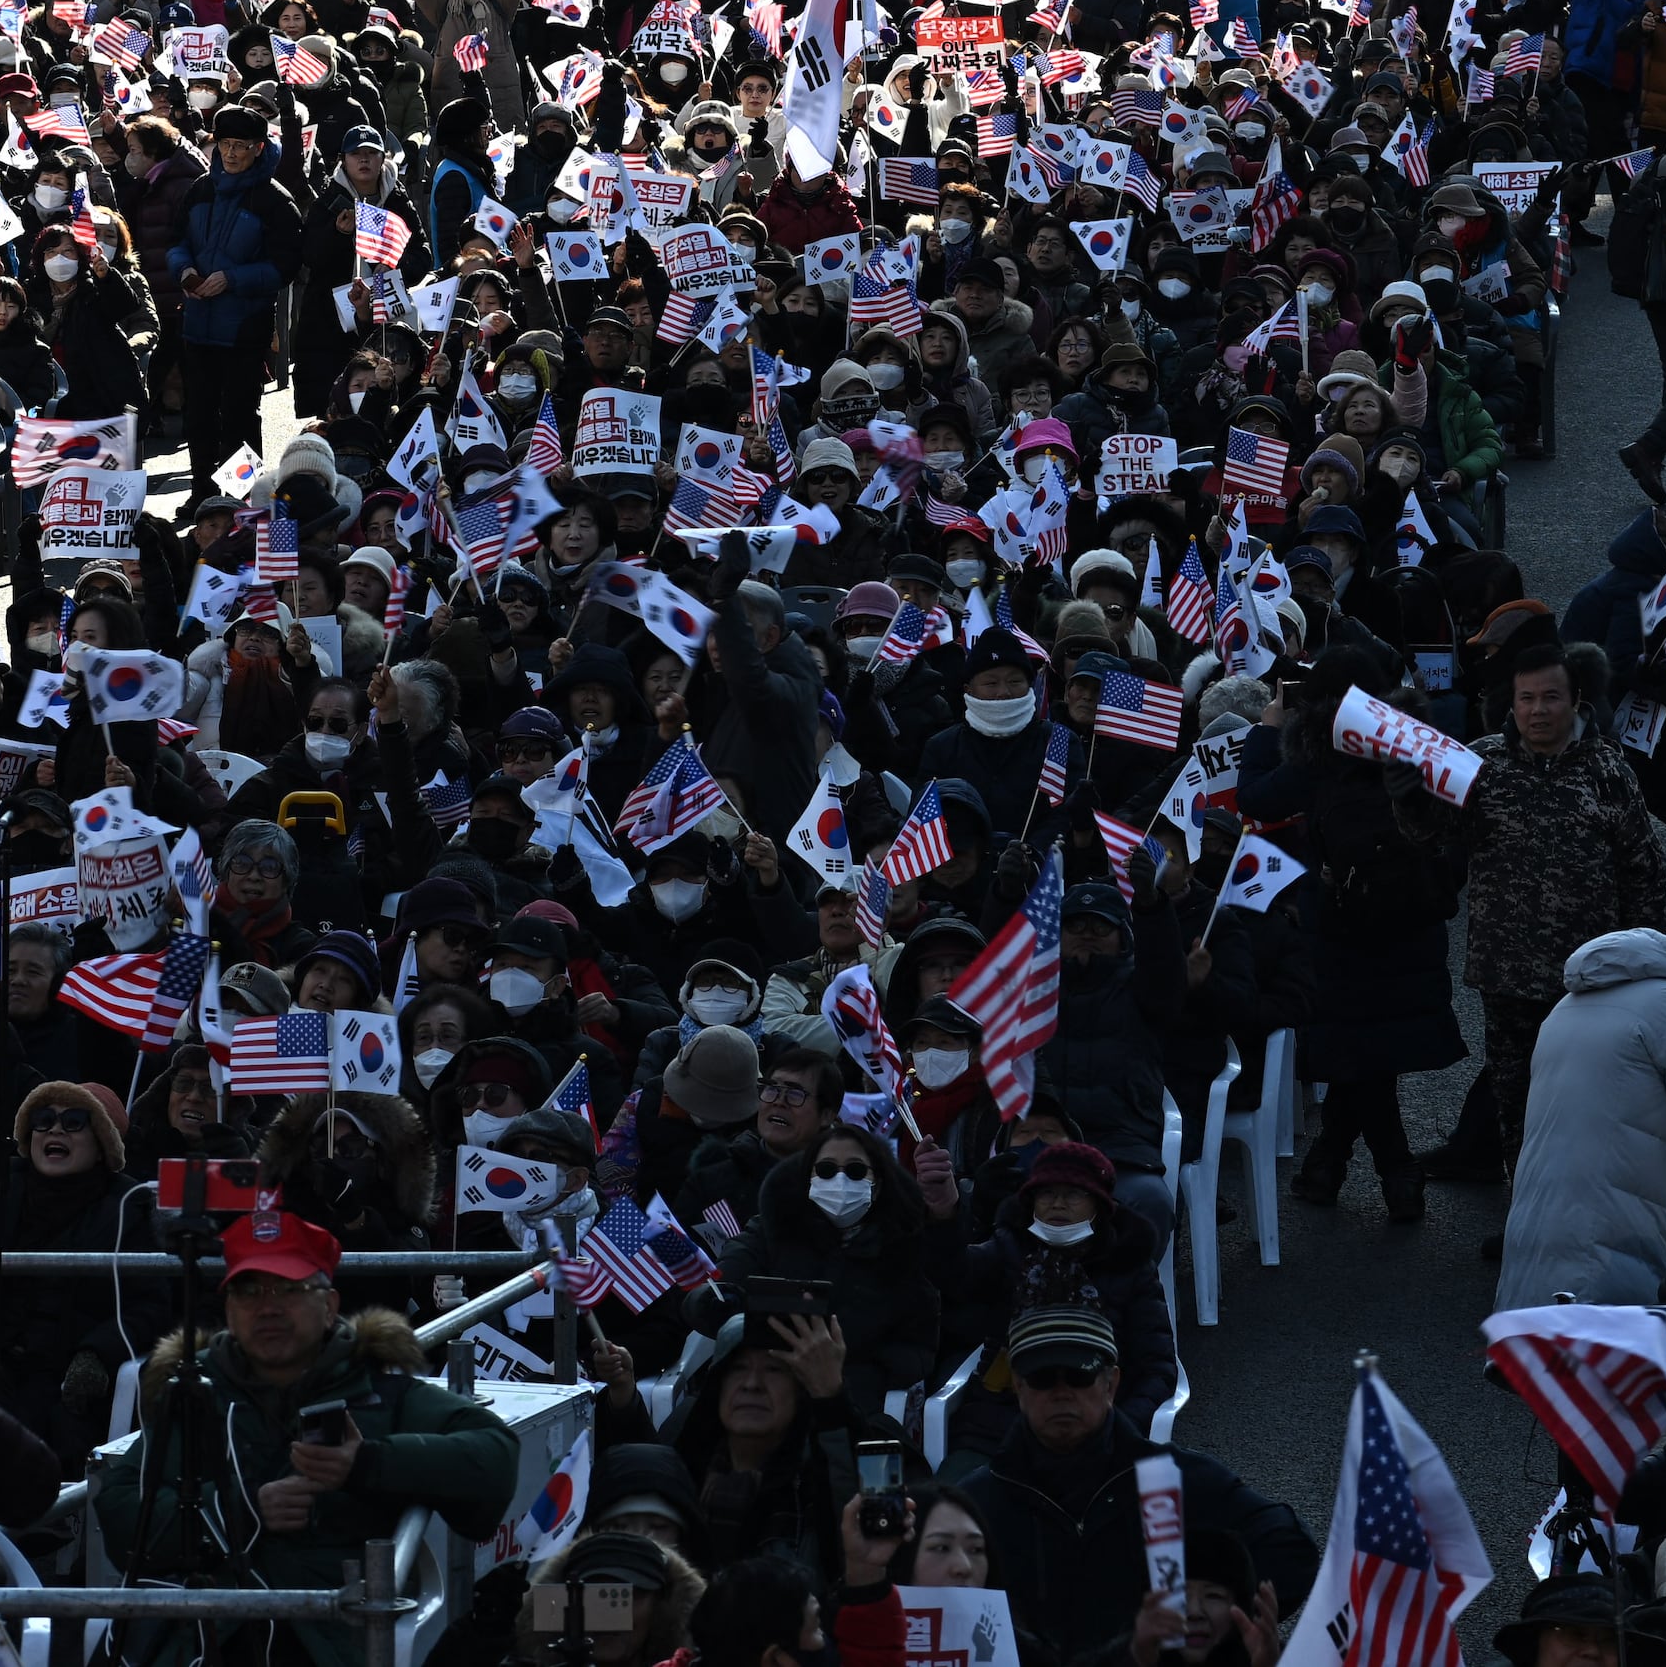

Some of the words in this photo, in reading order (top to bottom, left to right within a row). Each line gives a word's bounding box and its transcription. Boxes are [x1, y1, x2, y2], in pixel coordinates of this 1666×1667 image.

[648, 21, 679, 31] OUT
[919, 18, 999, 40] 부정선거
[942, 40, 976, 53] OUT
[923, 51, 1002, 72] 가짜국회
[634, 183, 682, 204] 소원은
[664, 234, 710, 259] 윤석열
[669, 249, 727, 275] 대통령과
[675, 268, 757, 292] 싸우겠습니다
[583, 401, 610, 420] 석열
[629, 429, 657, 447] 함께
[1107, 437, 1163, 455] STOP
[573, 446, 658, 466] 싸우겠습니다
[1118, 457, 1153, 472] THE
[1103, 473, 1170, 492] STEAL
[104, 509, 137, 526] 함께
[1365, 698, 1466, 756] STOP
[1373, 716, 1450, 764] THE
[1342, 729, 1456, 800] STEAL
[100, 849, 162, 884] 소원은
